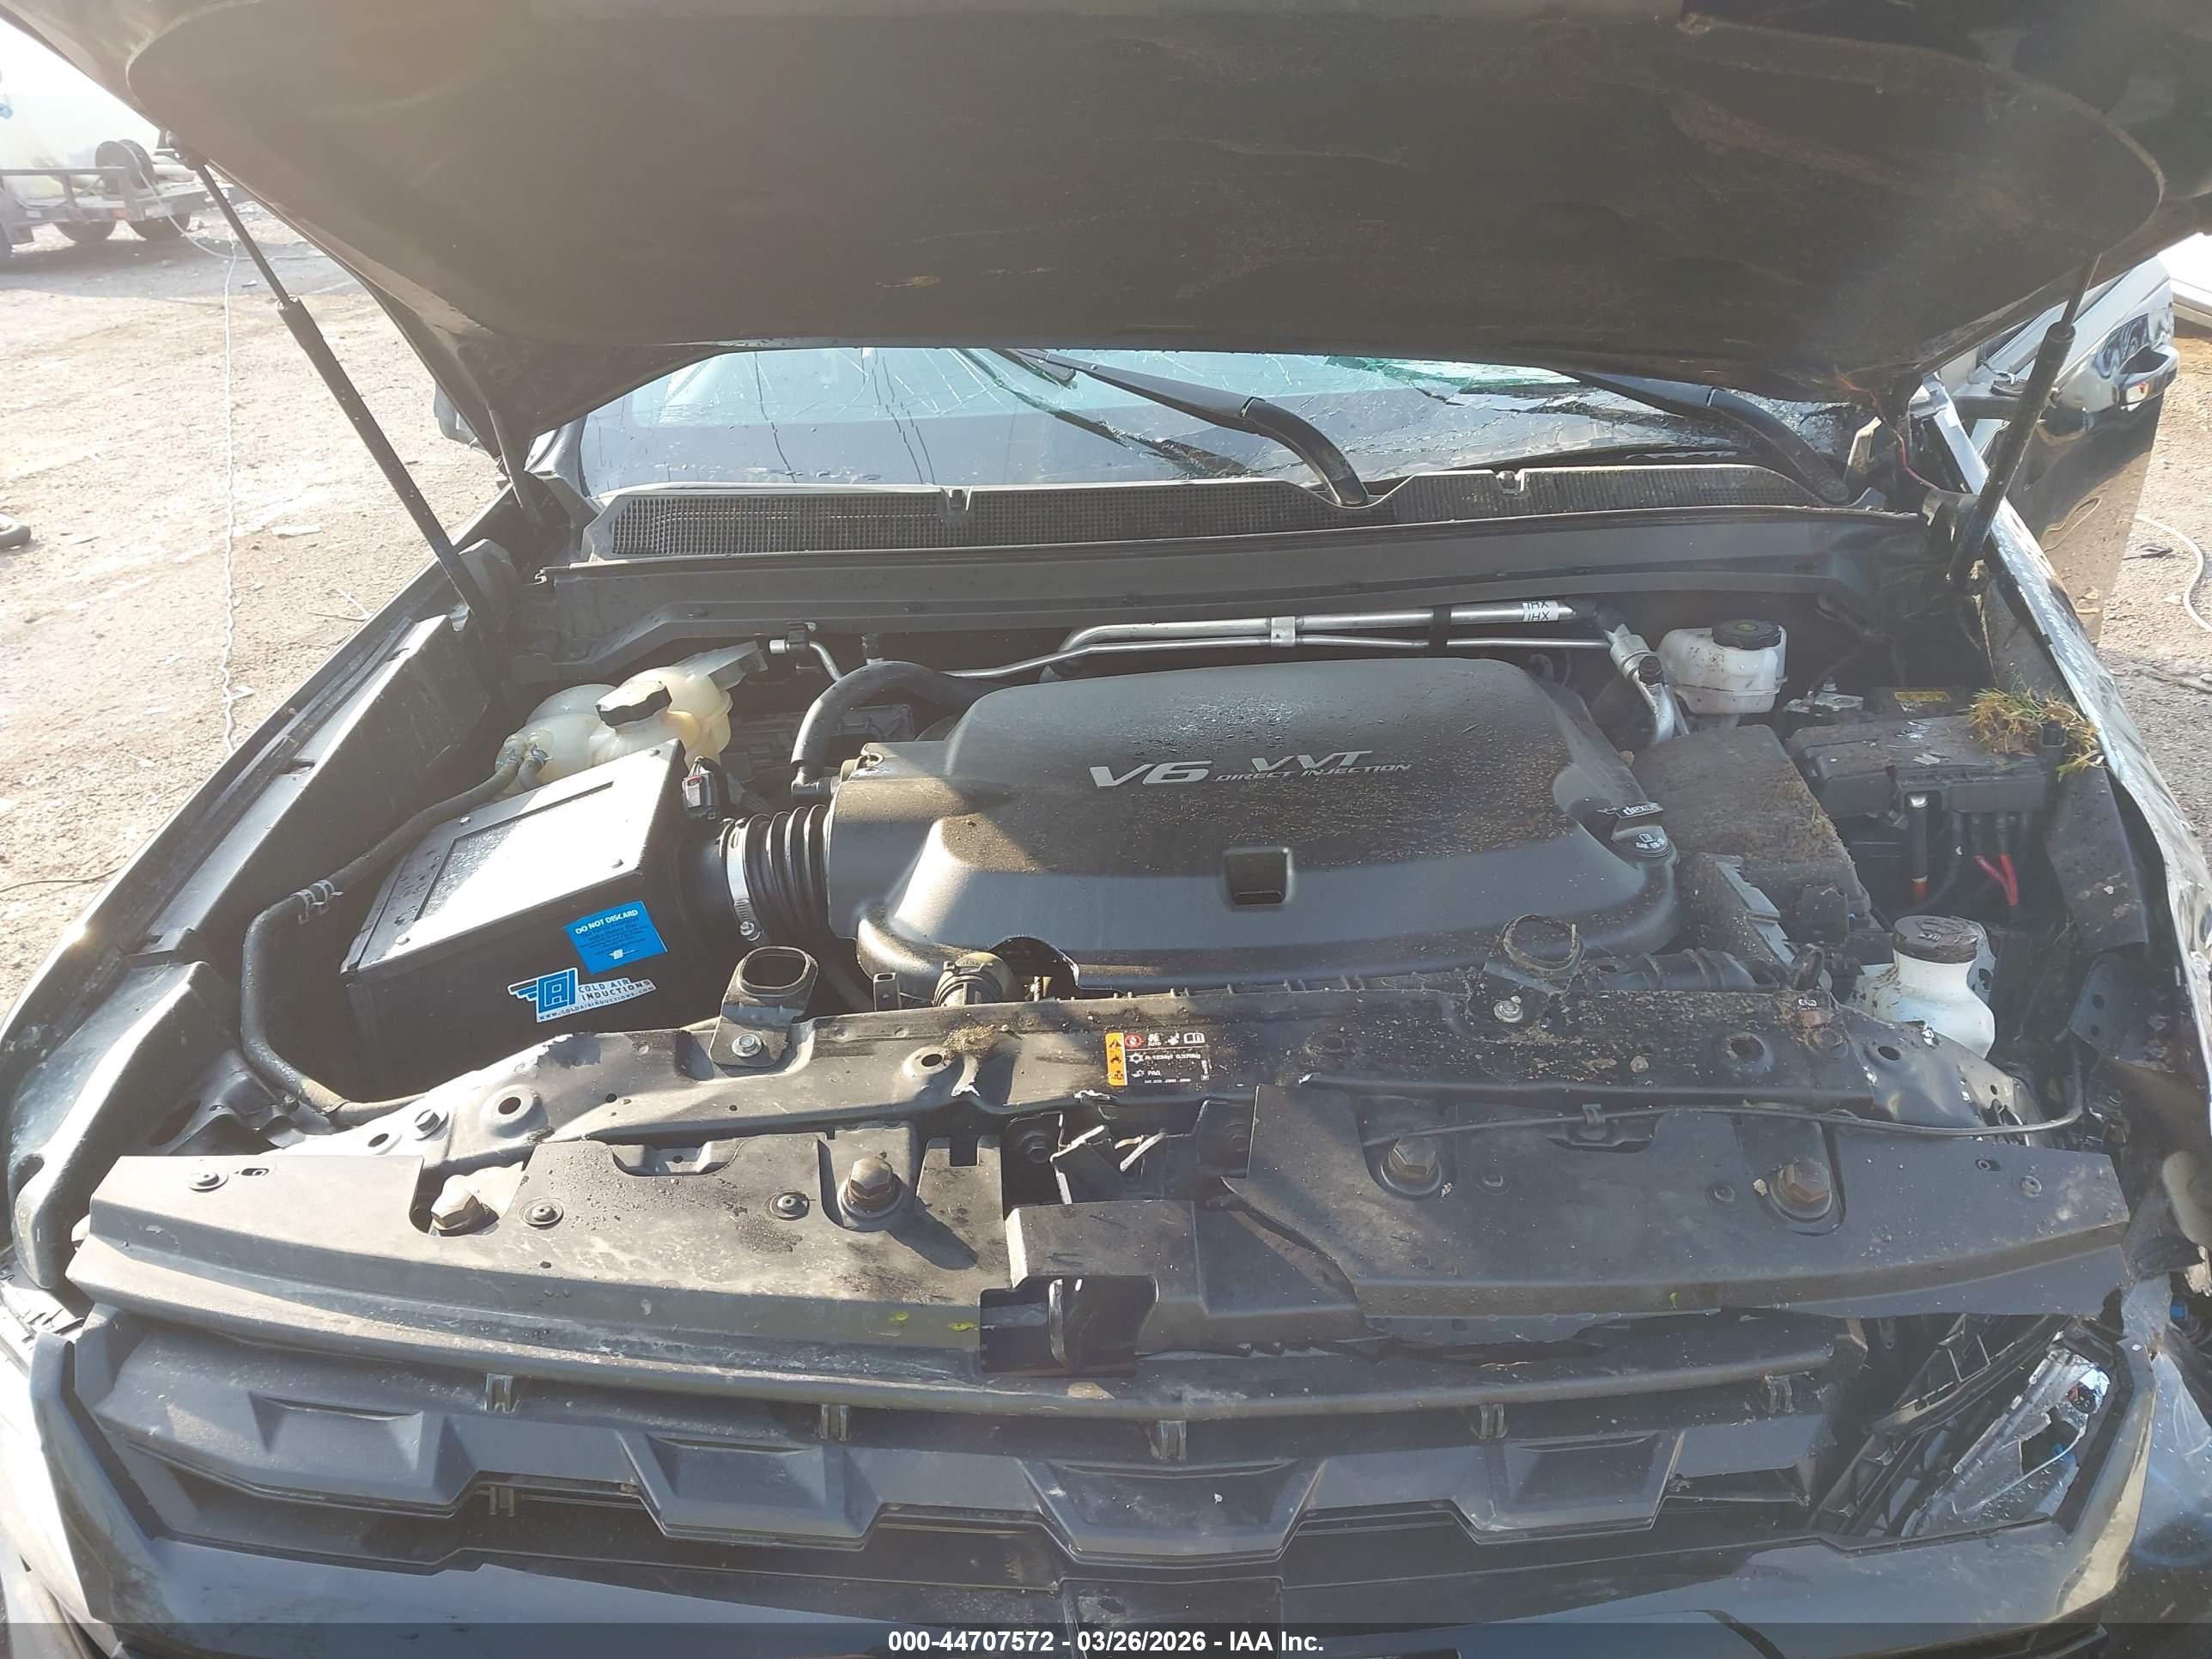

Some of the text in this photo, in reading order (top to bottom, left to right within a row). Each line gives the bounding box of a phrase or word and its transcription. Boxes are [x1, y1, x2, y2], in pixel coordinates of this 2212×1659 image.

[1251, 750, 1373, 773] VVT
[1089, 760, 1212, 788] V6
[1214, 763, 1413, 782] DIRECT INJECTION
[588, 919, 605, 929] NOT
[605, 909, 639, 924] DISCARD
[578, 979, 630, 994] COLD AIR
[581, 980, 651, 1002] INDUCTIONS
